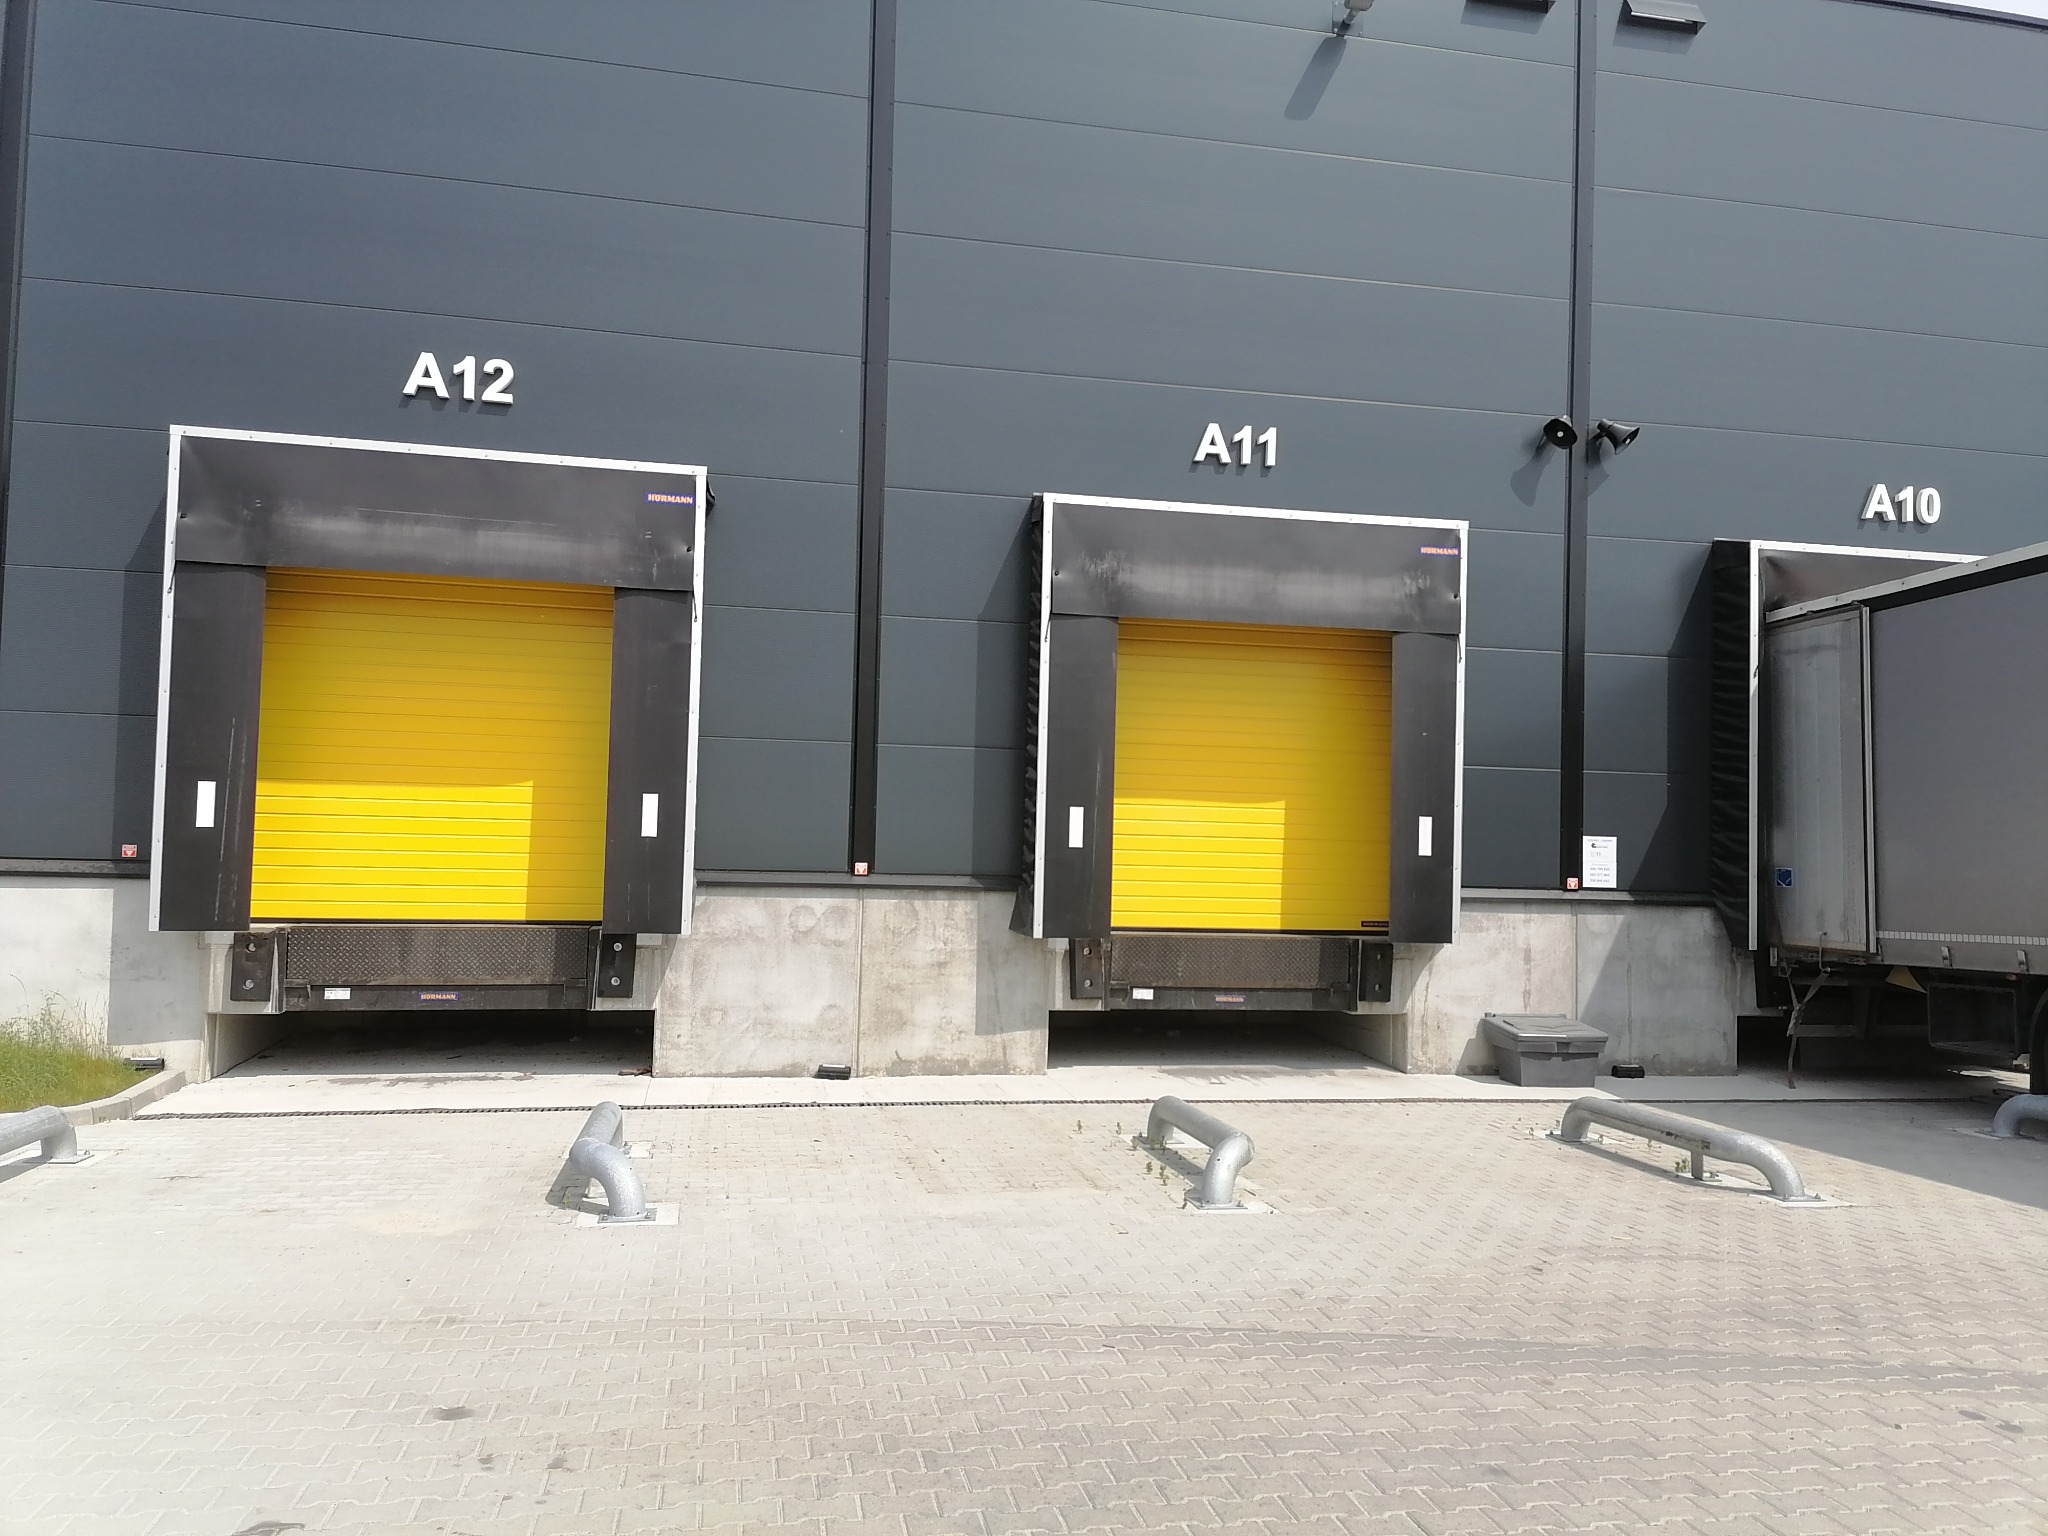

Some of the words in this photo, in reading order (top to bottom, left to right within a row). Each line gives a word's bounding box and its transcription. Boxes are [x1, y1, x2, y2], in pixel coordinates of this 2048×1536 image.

[402, 351, 514, 405] A12
[1192, 422, 1277, 467] A11
[1861, 483, 1941, 525] A10
